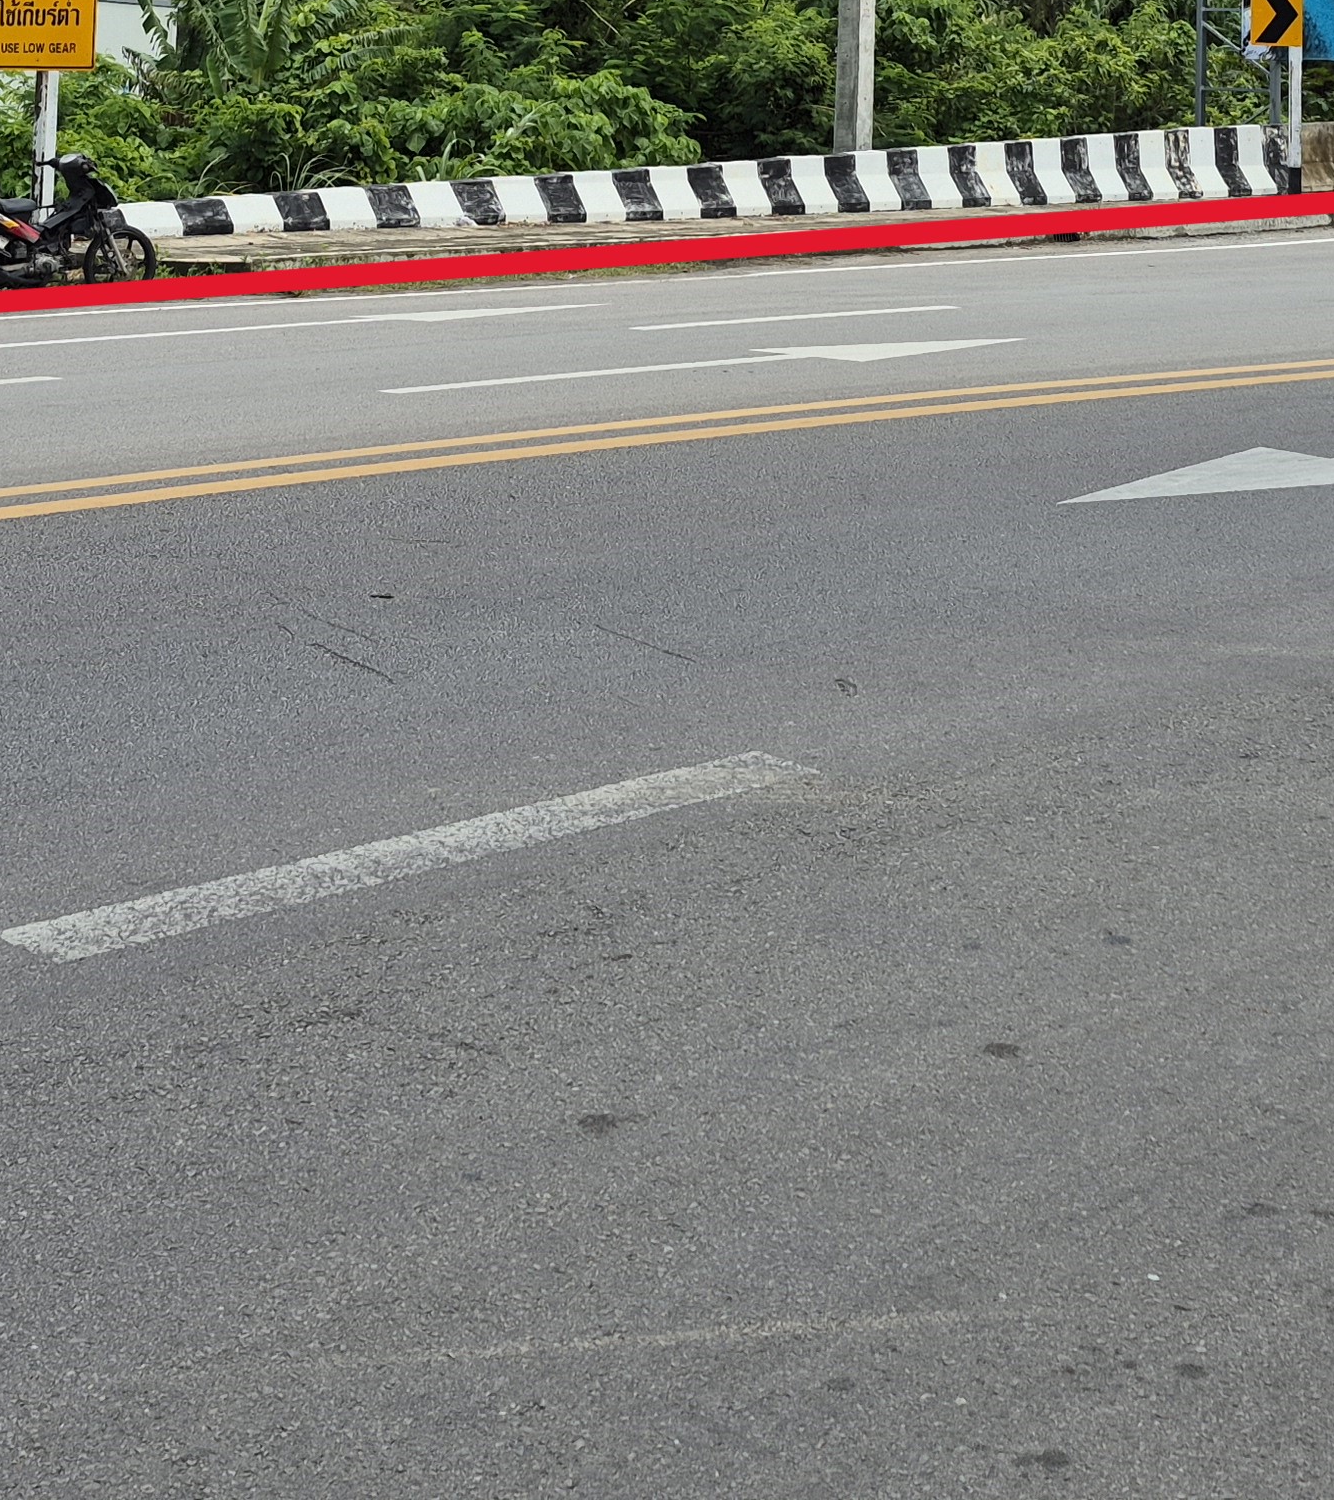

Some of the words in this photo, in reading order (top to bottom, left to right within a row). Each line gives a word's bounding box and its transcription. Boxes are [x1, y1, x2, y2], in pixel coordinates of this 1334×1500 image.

[1, 42, 19, 53] USE
[23, 42, 45, 53] LOW
[48, 42, 76, 53] GEAR
